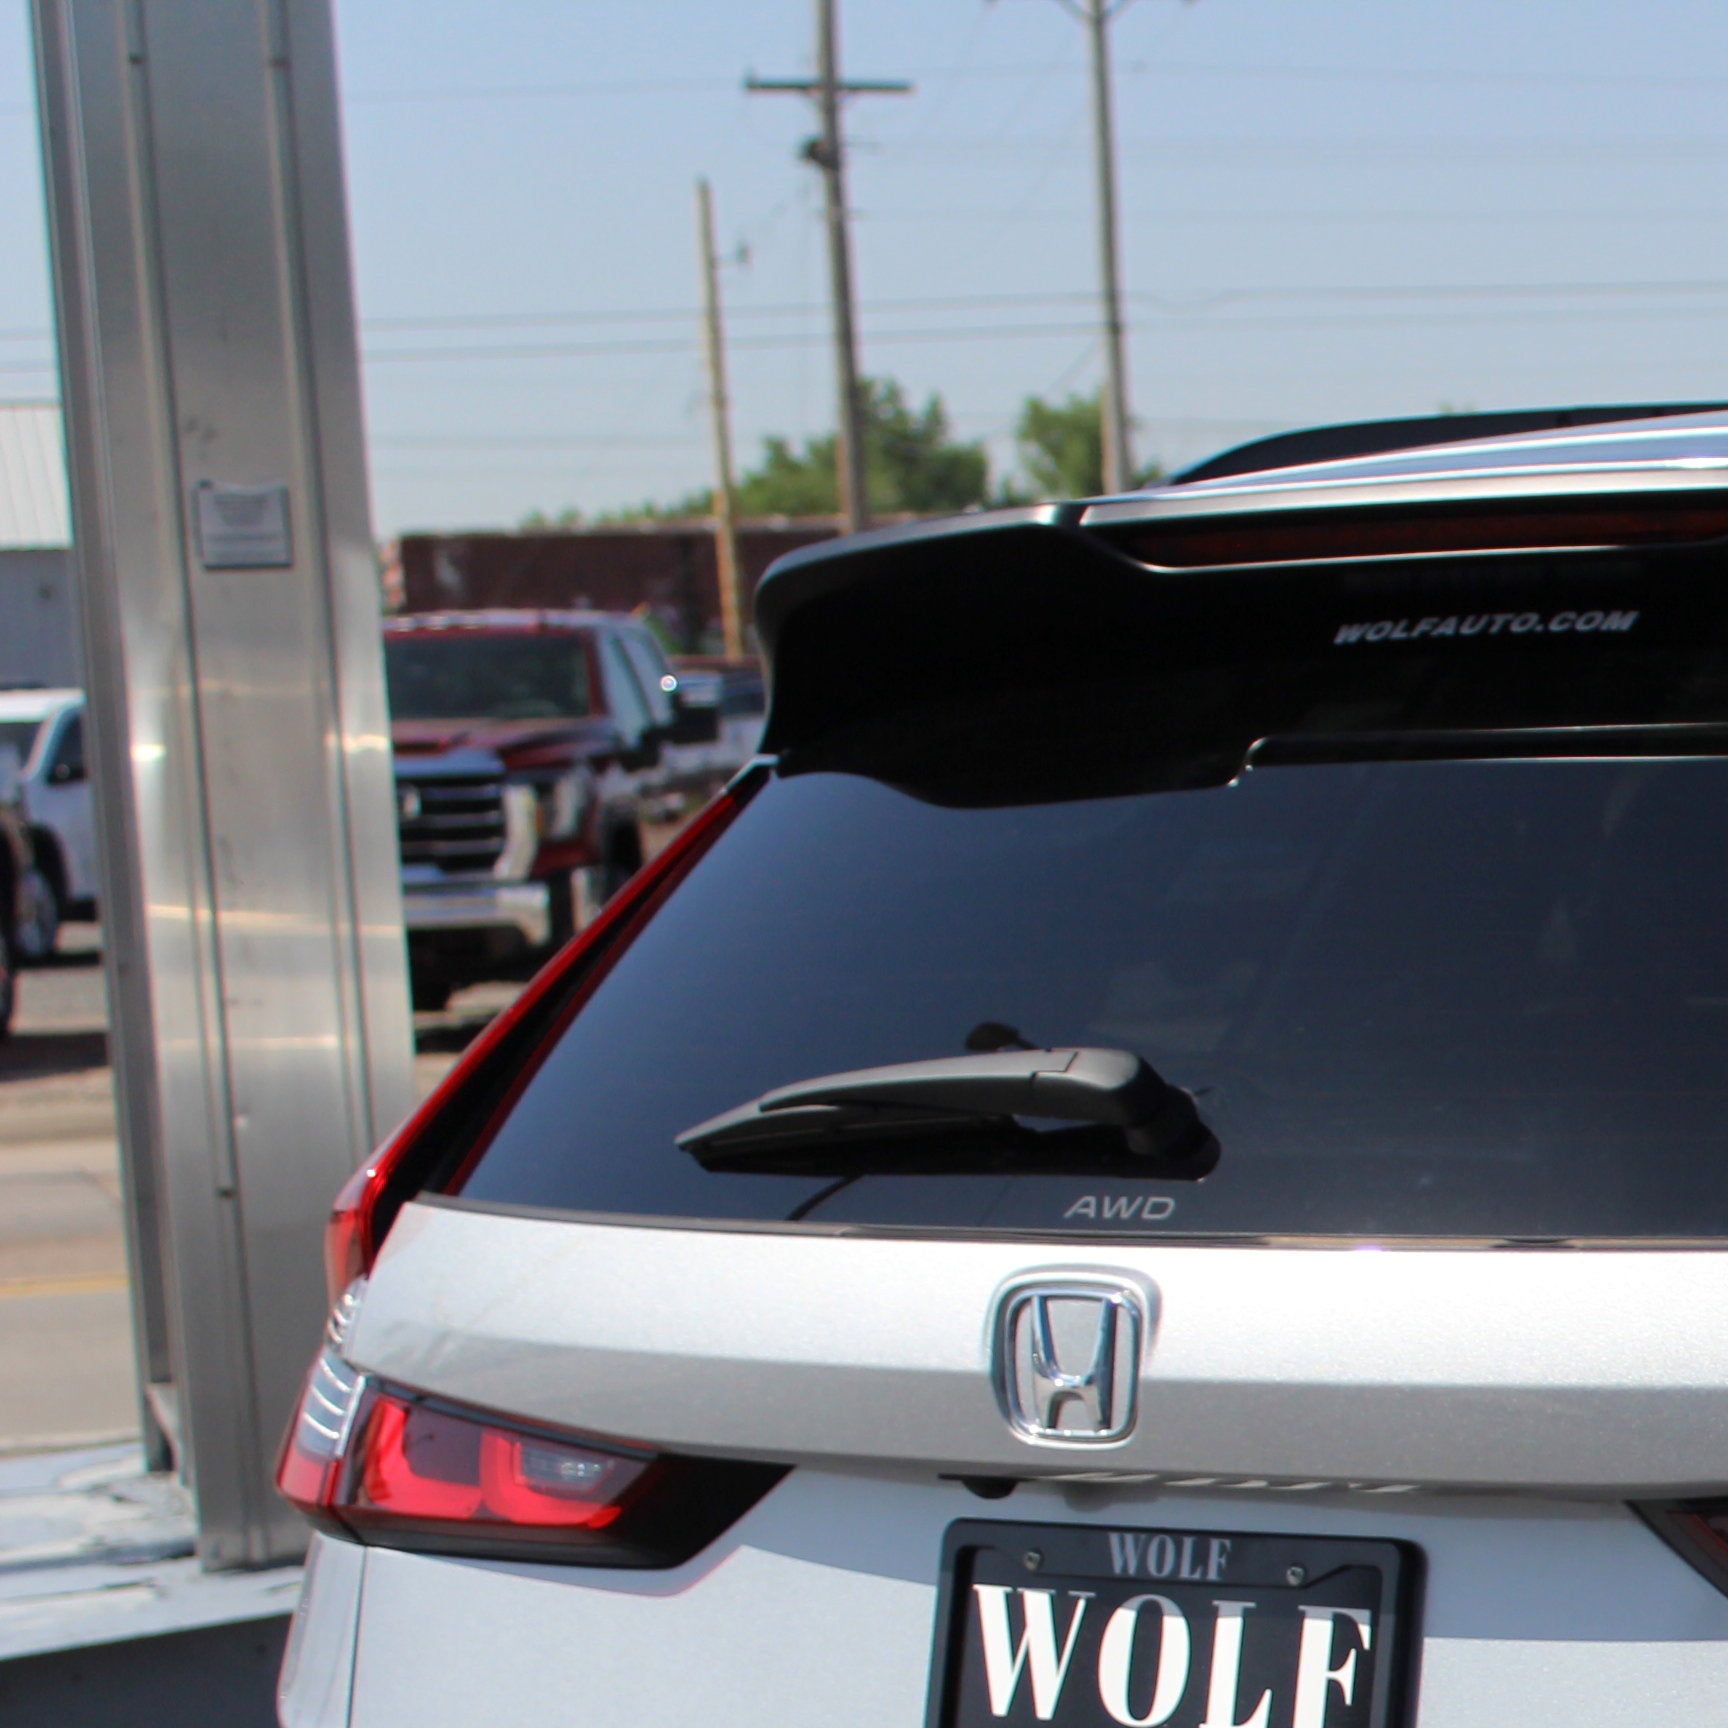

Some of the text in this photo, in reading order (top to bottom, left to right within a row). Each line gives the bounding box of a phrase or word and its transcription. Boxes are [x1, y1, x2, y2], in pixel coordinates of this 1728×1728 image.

[1333, 610, 1640, 645] WOLFAUTO.COM
[1063, 1195, 1176, 1220] AWD
[1108, 1531, 1232, 1581] WOLF
